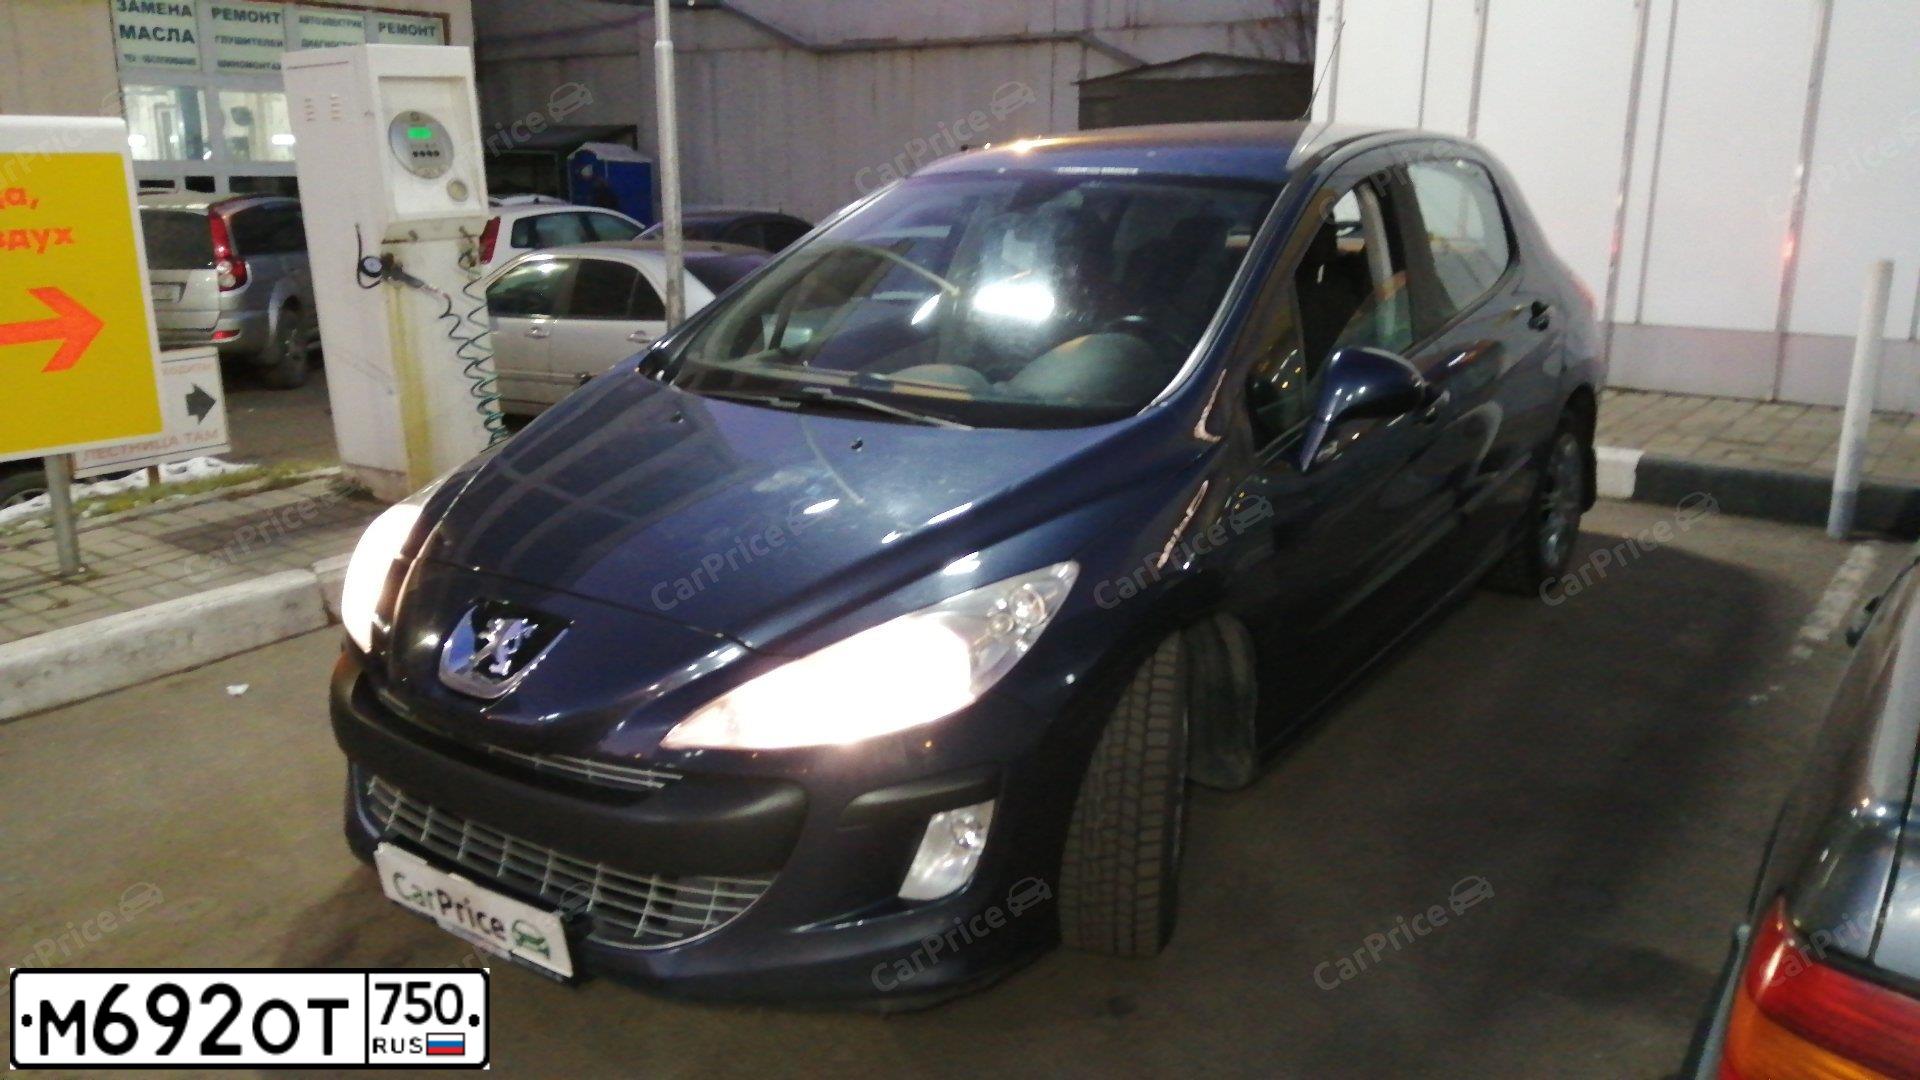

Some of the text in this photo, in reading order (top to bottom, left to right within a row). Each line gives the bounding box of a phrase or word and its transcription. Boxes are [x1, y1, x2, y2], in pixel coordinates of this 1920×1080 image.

[117, 0, 192, 17] ЗАМЕНА
[211, 7, 281, 24] РЕМОНТ
[119, 24, 195, 44] МАСЛА
[378, 22, 436, 37] РЕМОНТ
[392, 871, 507, 941] CarPrice
